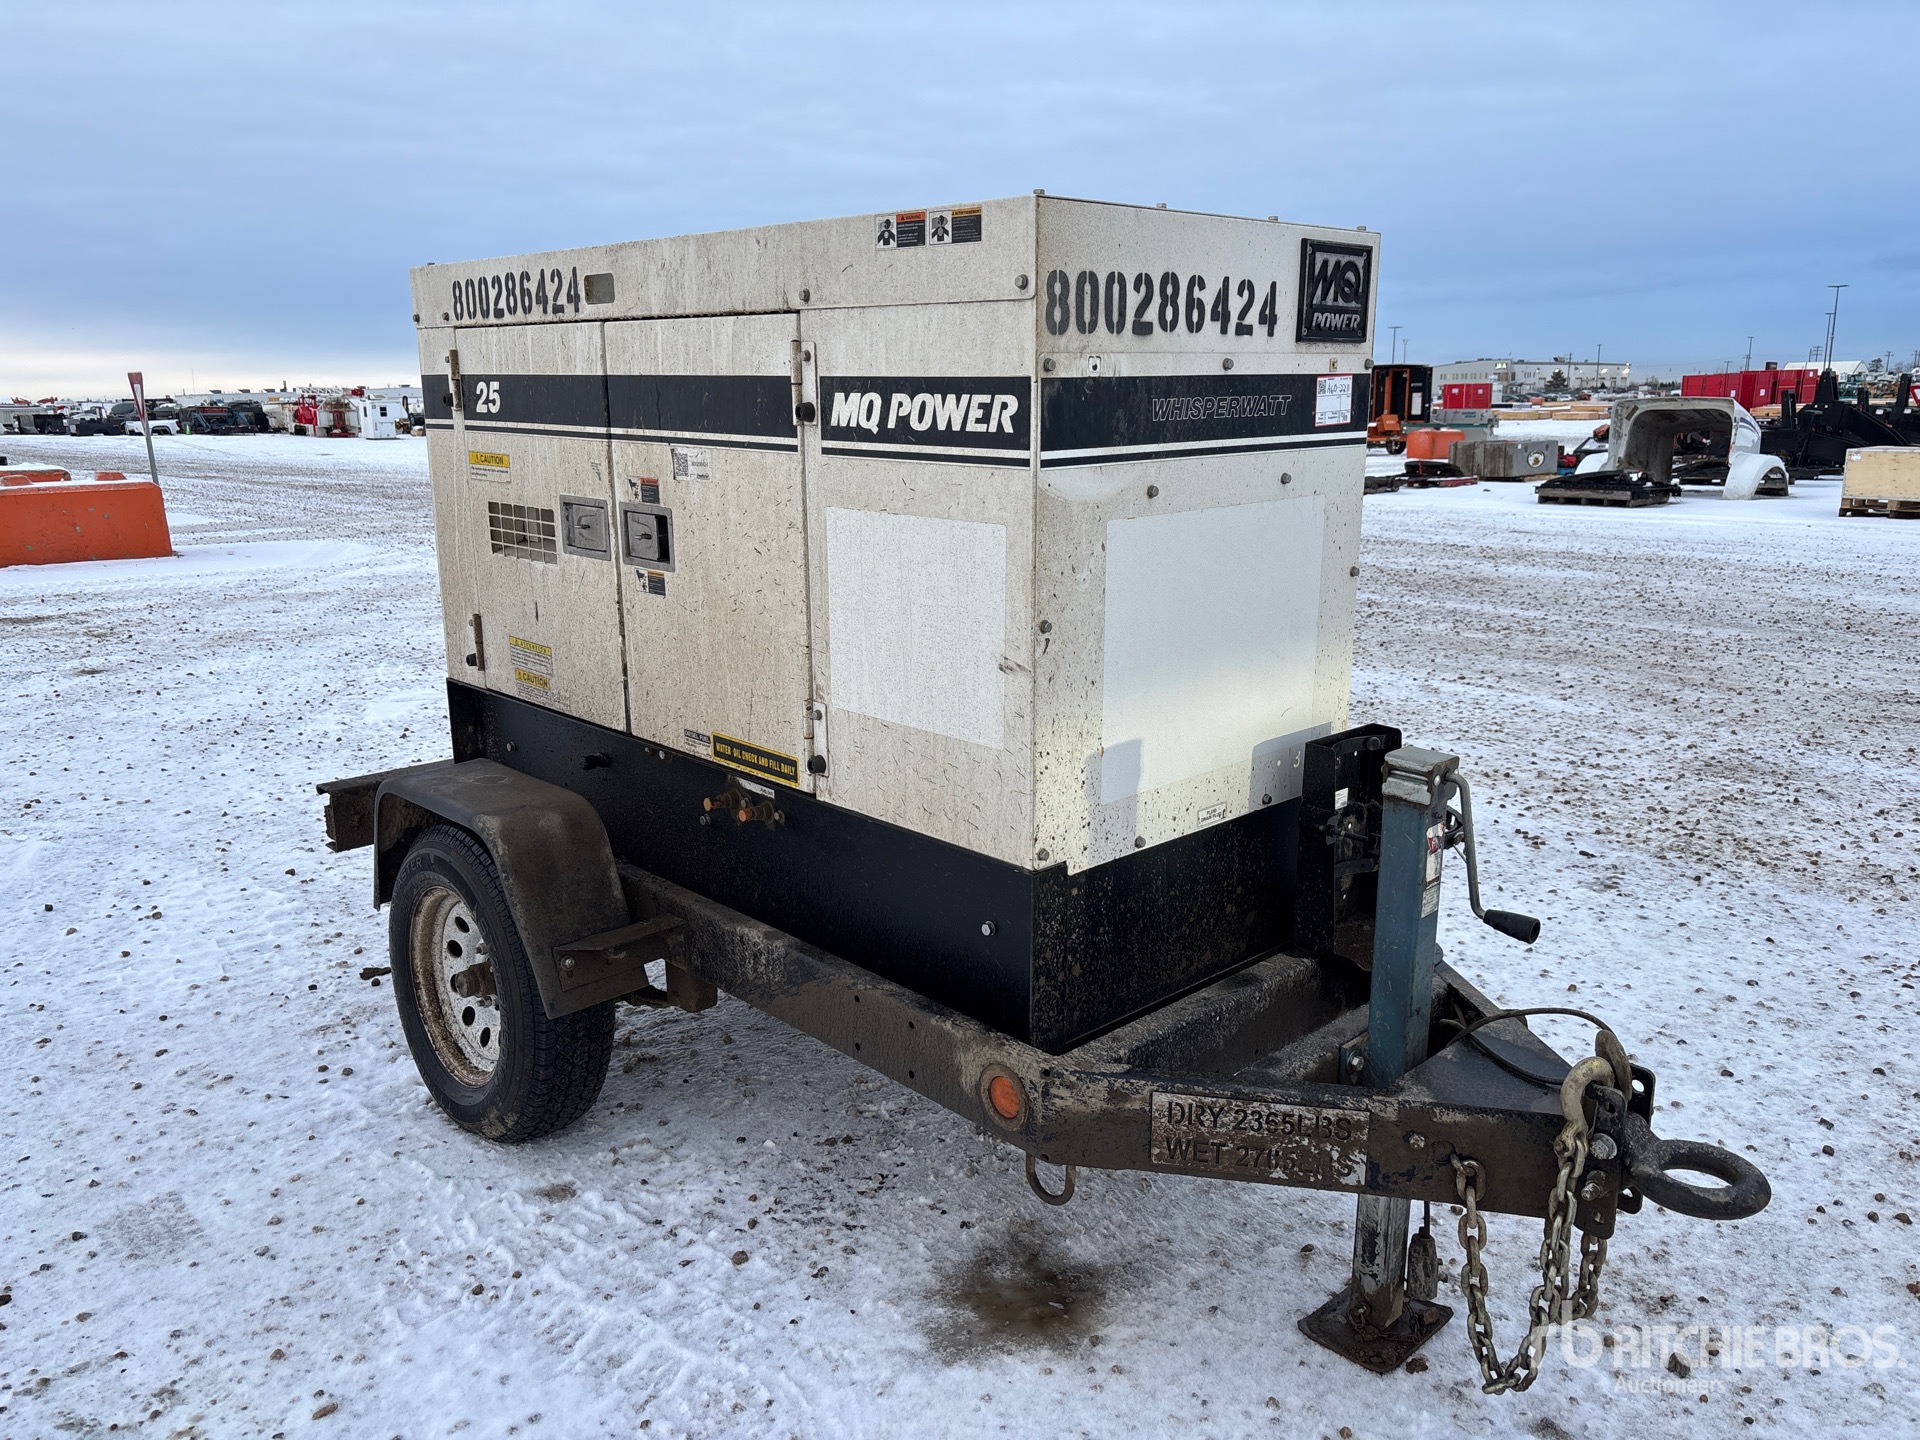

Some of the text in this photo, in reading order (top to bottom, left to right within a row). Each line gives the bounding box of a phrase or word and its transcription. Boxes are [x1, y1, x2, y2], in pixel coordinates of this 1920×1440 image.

[452, 266, 580, 321] 800286424
[1306, 257, 1363, 305] MQ
[1046, 269, 1278, 337] 800286424
[1311, 312, 1361, 331] POWER
[475, 381, 500, 413] 25
[830, 392, 1019, 434] MQ POWER
[1152, 395, 1292, 421] WHISPERWATT
[480, 454, 504, 464] CAUTION
[522, 672, 548, 688] CAUTION
[716, 742, 731, 755] WATER
[733, 748, 741, 759] OIL
[742, 751, 759, 763] CHECK
[759, 755, 768, 767] AND
[769, 759, 780, 771] FILL
[781, 764, 796, 776] DAILY
[1168, 1101, 1351, 1140] DRY 2365LBS
[1166, 1136, 1227, 1164] WET
